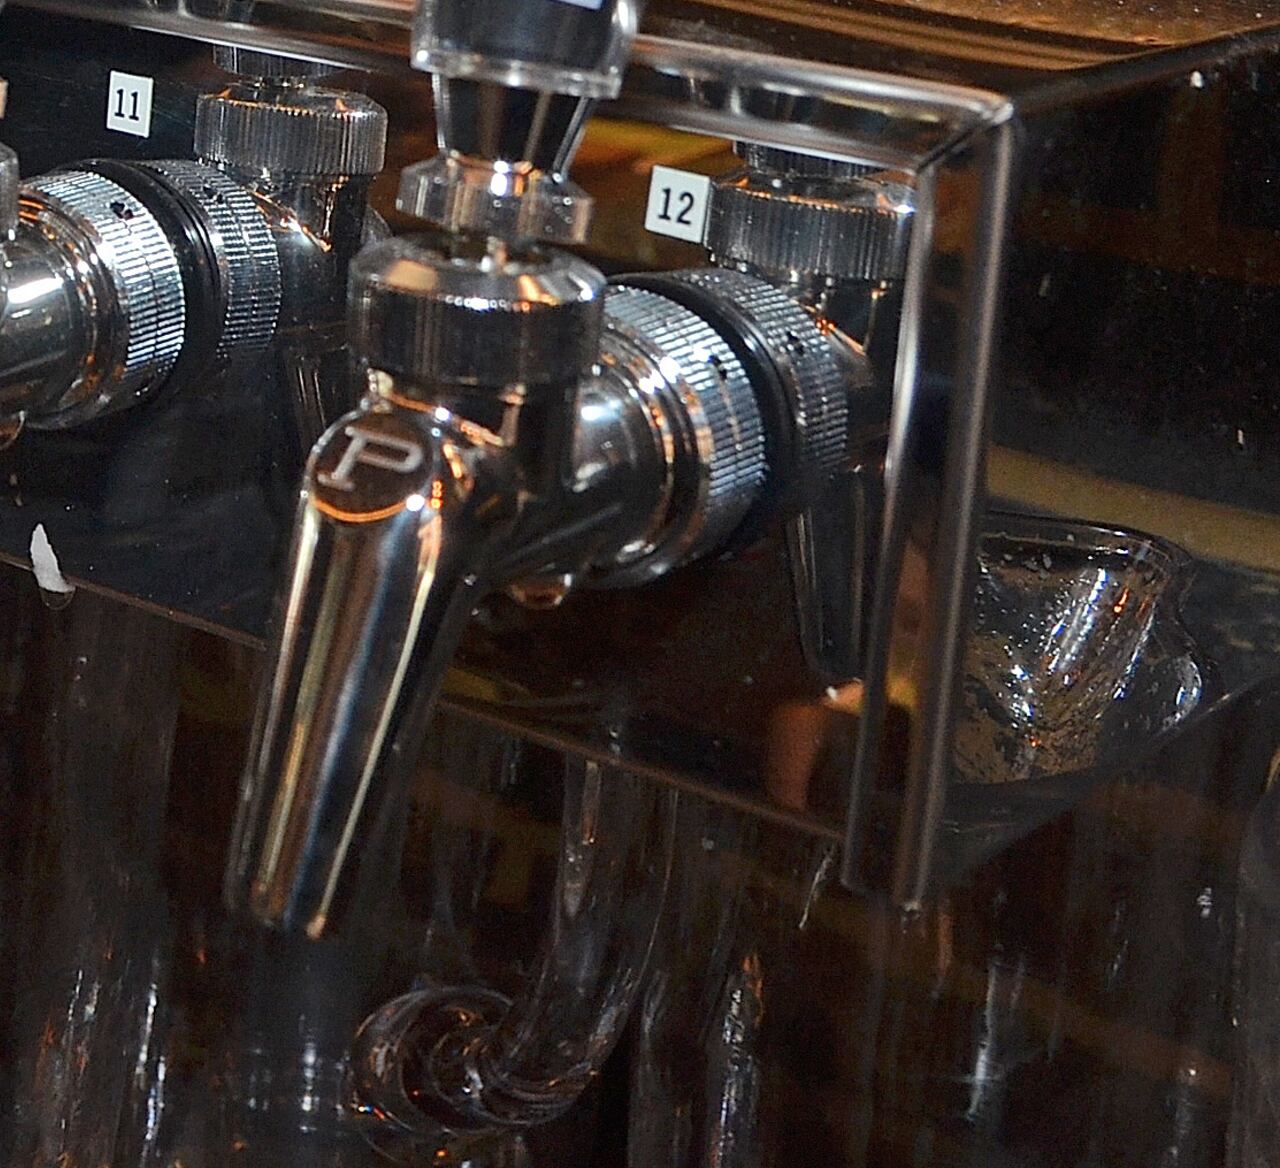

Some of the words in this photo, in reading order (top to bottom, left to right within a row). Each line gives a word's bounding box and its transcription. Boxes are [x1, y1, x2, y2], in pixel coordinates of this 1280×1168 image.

[113, 88, 140, 121] 11
[657, 187, 695, 225] 12
[317, 426, 424, 492] P
